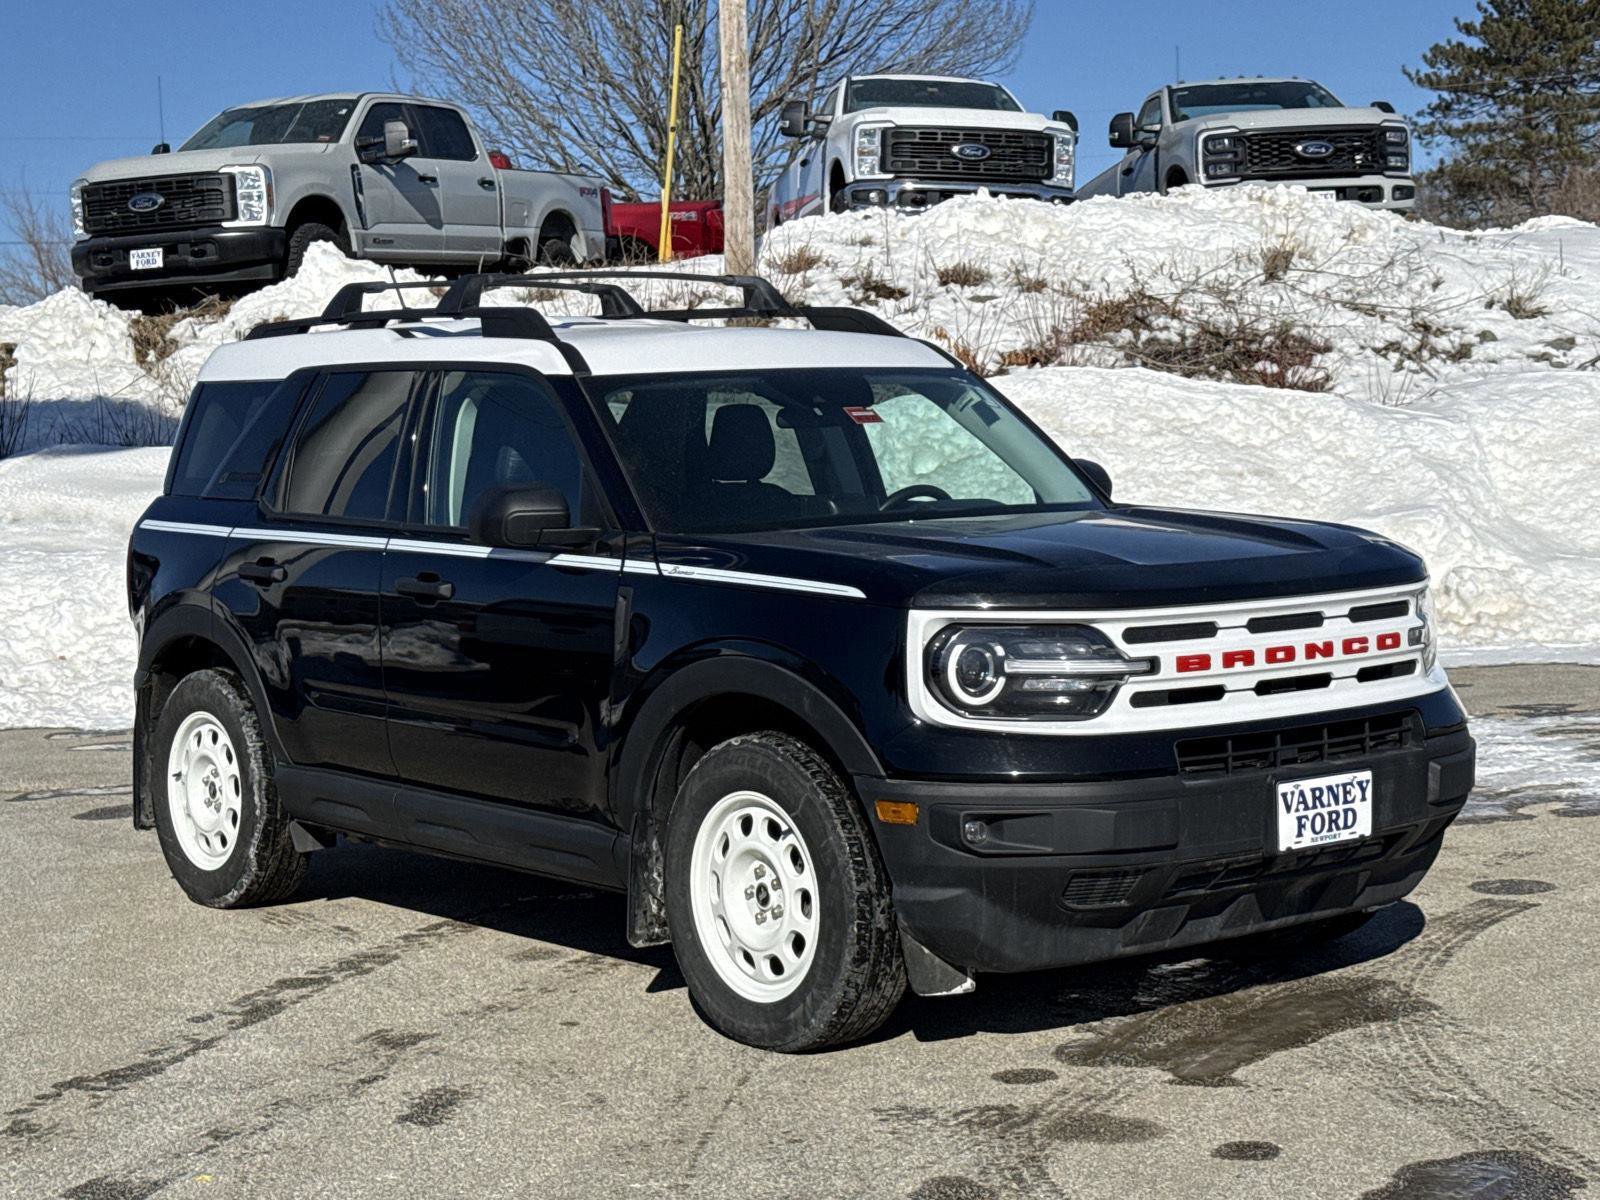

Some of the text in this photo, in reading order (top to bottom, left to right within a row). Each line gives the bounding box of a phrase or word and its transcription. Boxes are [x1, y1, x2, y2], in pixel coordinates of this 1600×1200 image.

[131, 250, 161, 259] VARNEY
[136, 258, 157, 266] FORD
[1176, 631, 1402, 673] BRONCO
[1280, 779, 1371, 814] VARNEY
[1295, 807, 1358, 839] FORD
